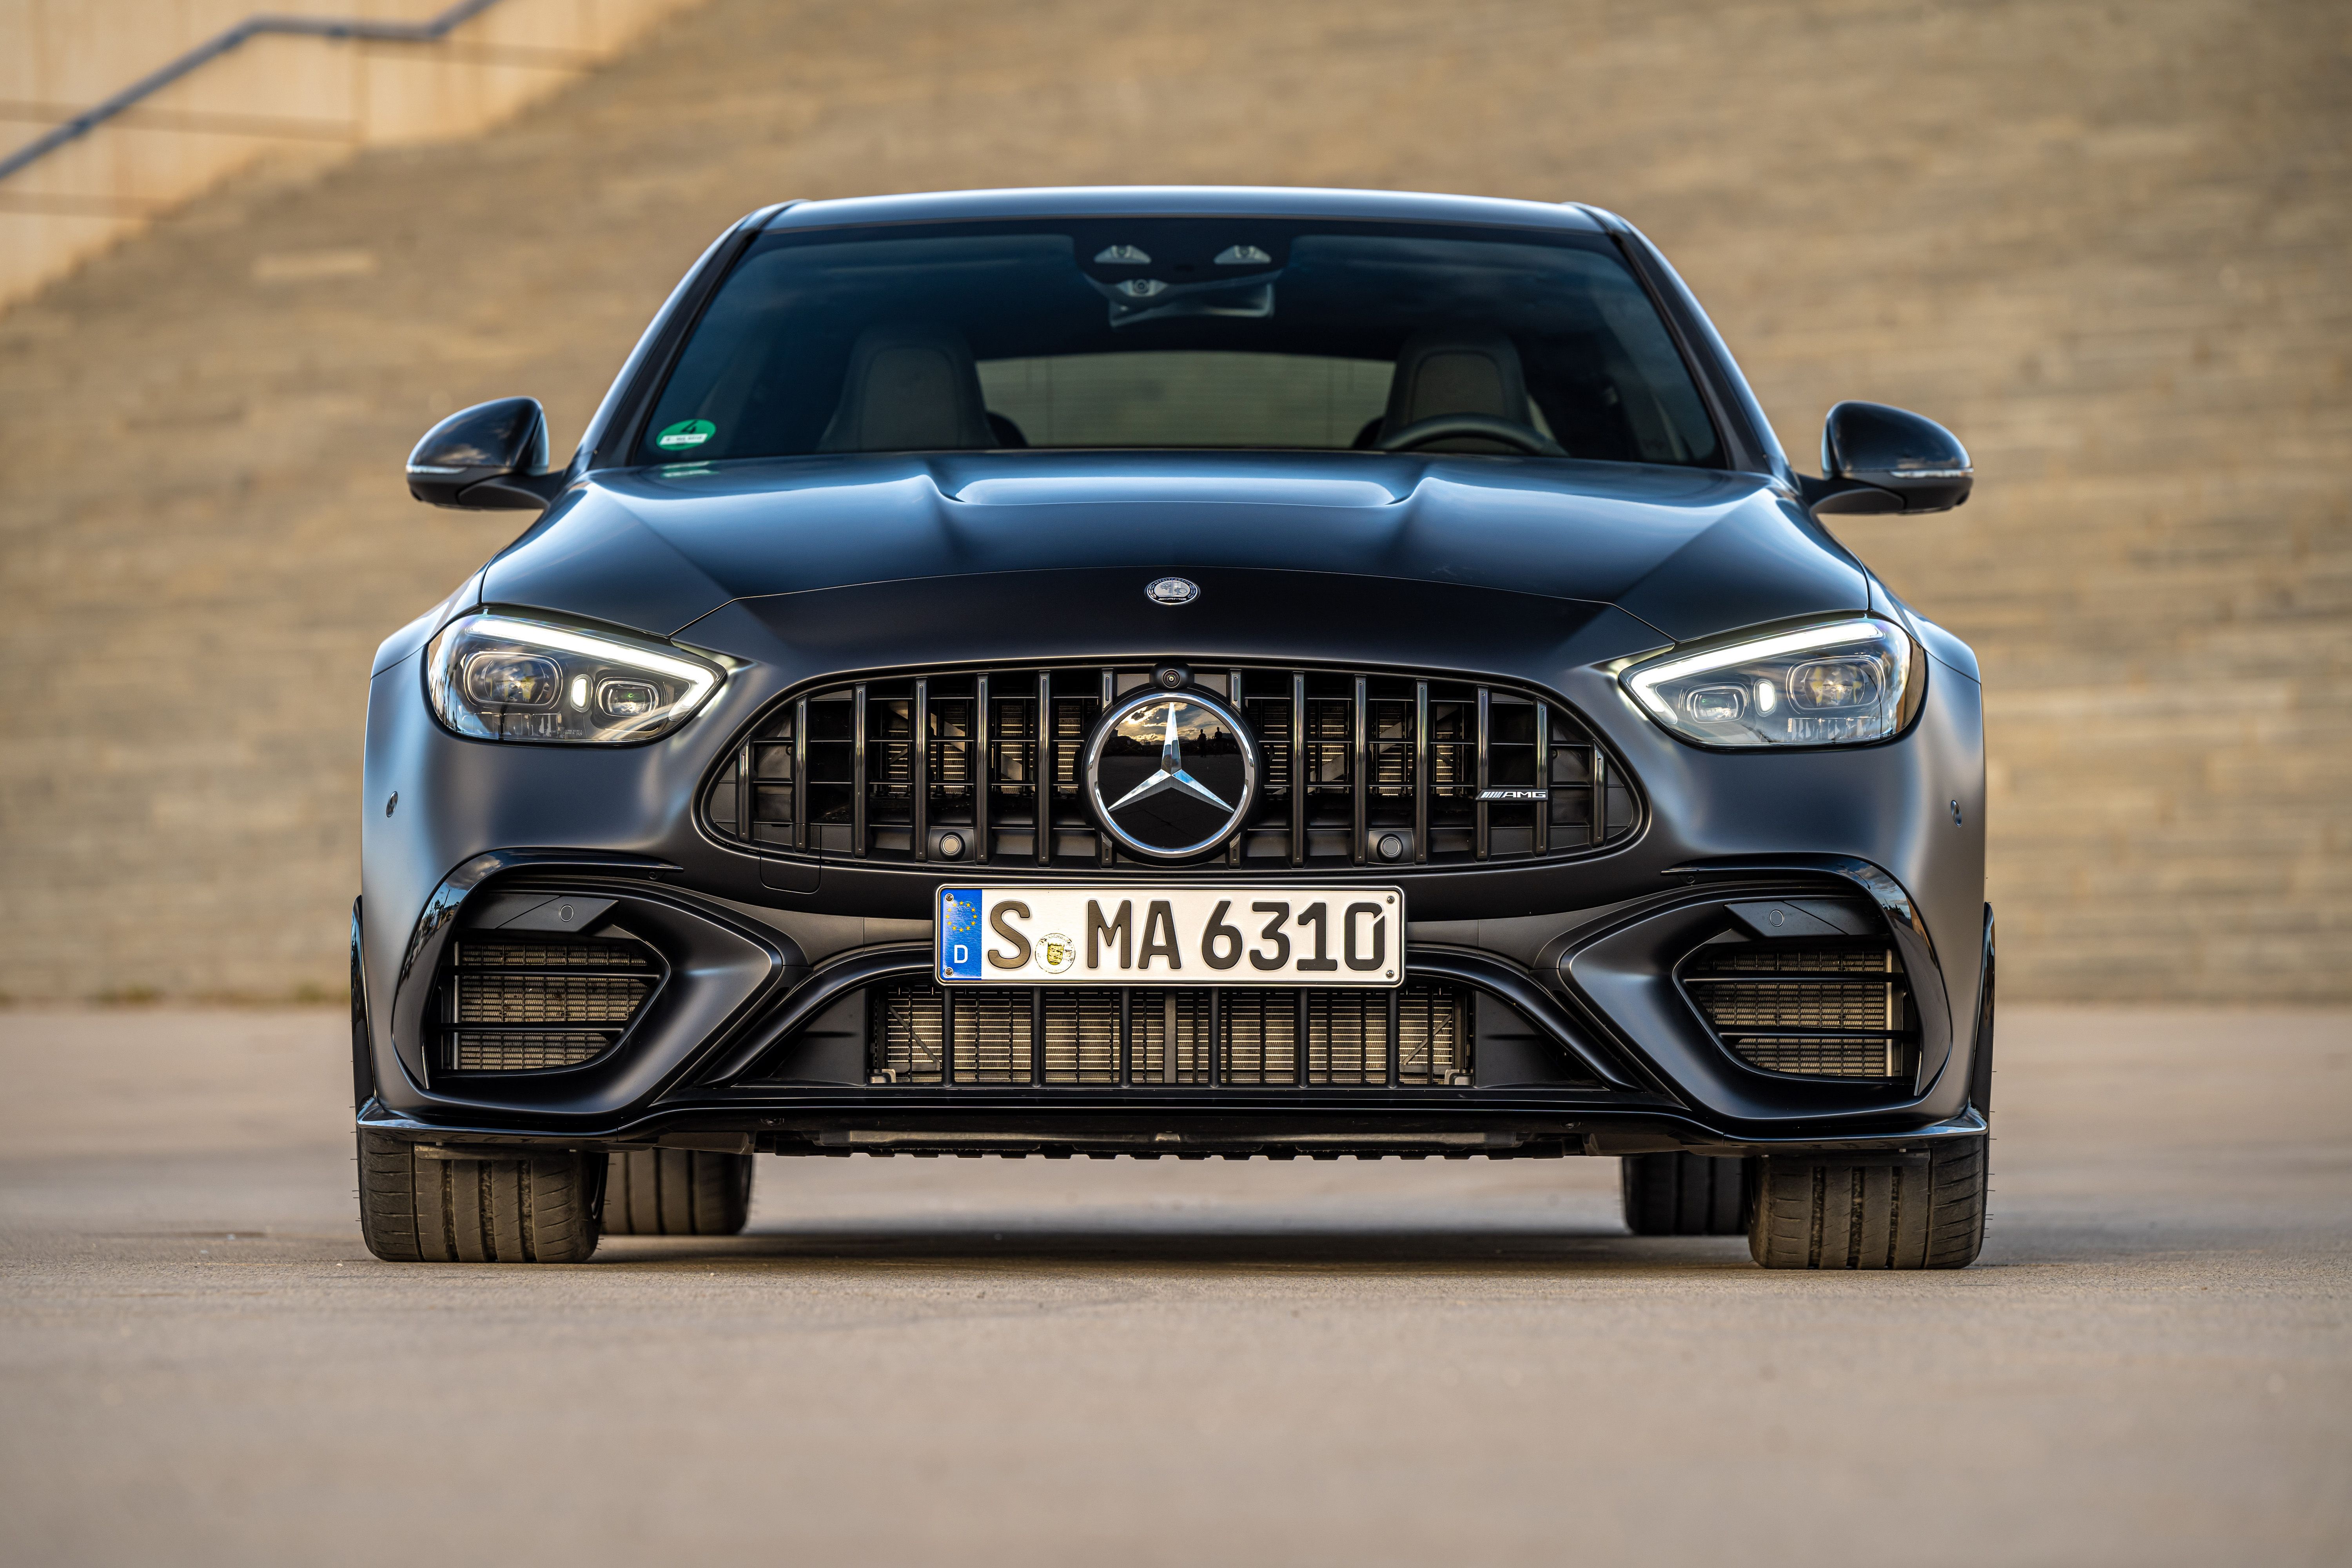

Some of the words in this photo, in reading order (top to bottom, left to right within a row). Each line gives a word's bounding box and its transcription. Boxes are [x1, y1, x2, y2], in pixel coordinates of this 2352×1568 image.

[954, 945, 968, 964] D
[987, 900, 1031, 969] S
[1087, 900, 1181, 969] MA
[1201, 900, 1385, 971] 6310
